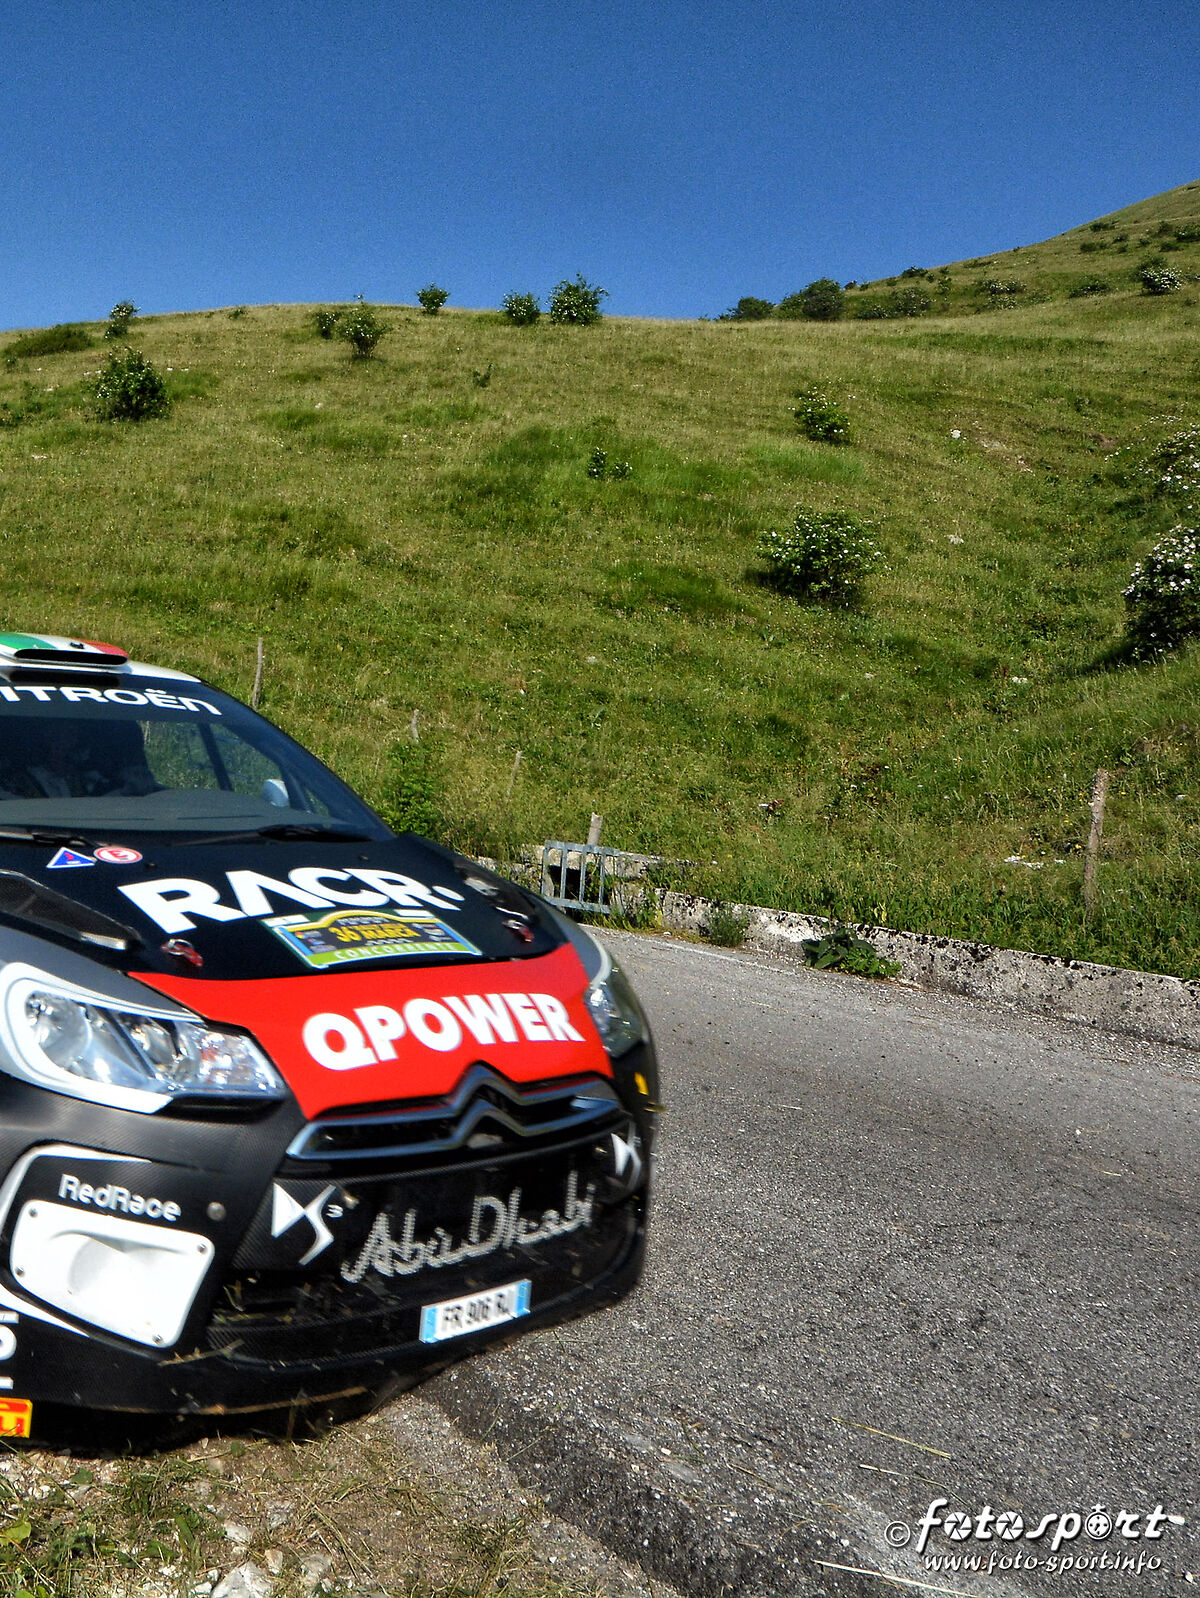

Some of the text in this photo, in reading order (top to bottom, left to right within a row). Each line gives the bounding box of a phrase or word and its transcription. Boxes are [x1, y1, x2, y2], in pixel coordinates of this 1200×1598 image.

[333, 942, 457, 960] CONCORRENTE
[302, 993, 587, 1071] QPOWER
[58, 1173, 182, 1221] RedRace
